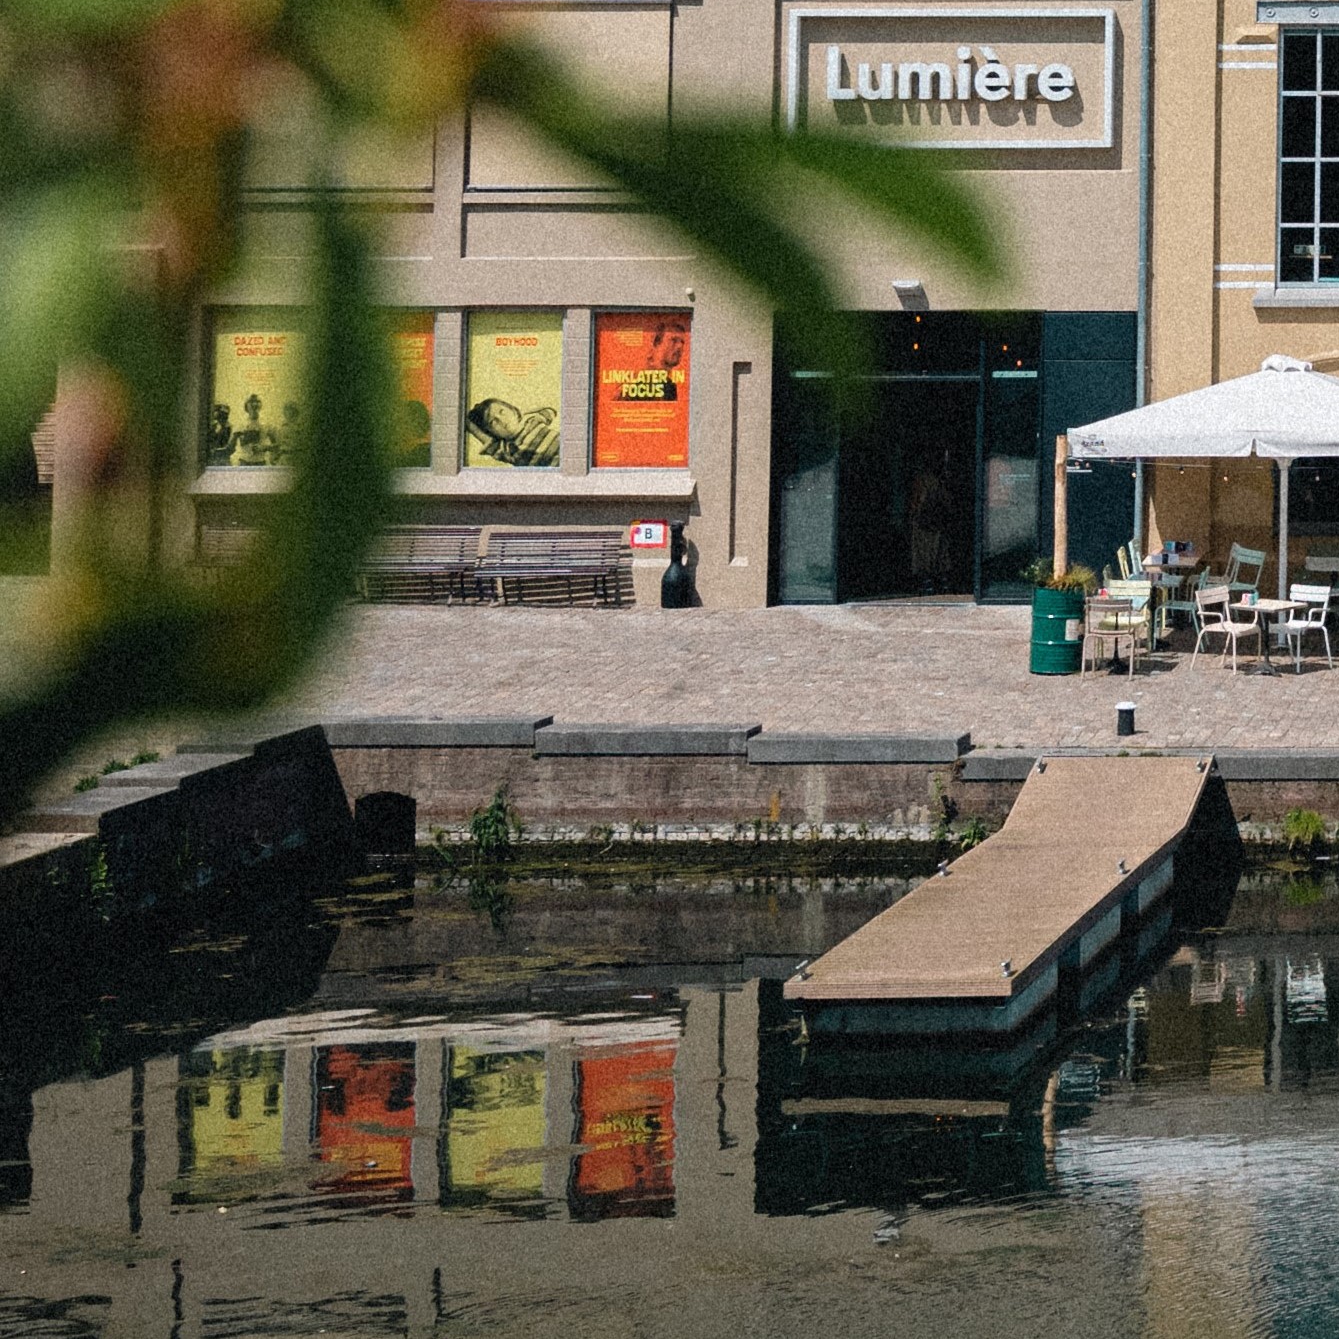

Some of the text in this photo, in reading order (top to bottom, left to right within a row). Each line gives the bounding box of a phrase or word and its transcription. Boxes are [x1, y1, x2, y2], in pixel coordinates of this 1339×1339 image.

[827, 45, 1076, 102] Lumière
[234, 336, 264, 346] DAZED
[495, 337, 538, 347] BOYHOOD
[602, 369, 685, 384] LINKLATER IN
[621, 383, 665, 398] FOCUS
[645, 528, 653, 539] B
